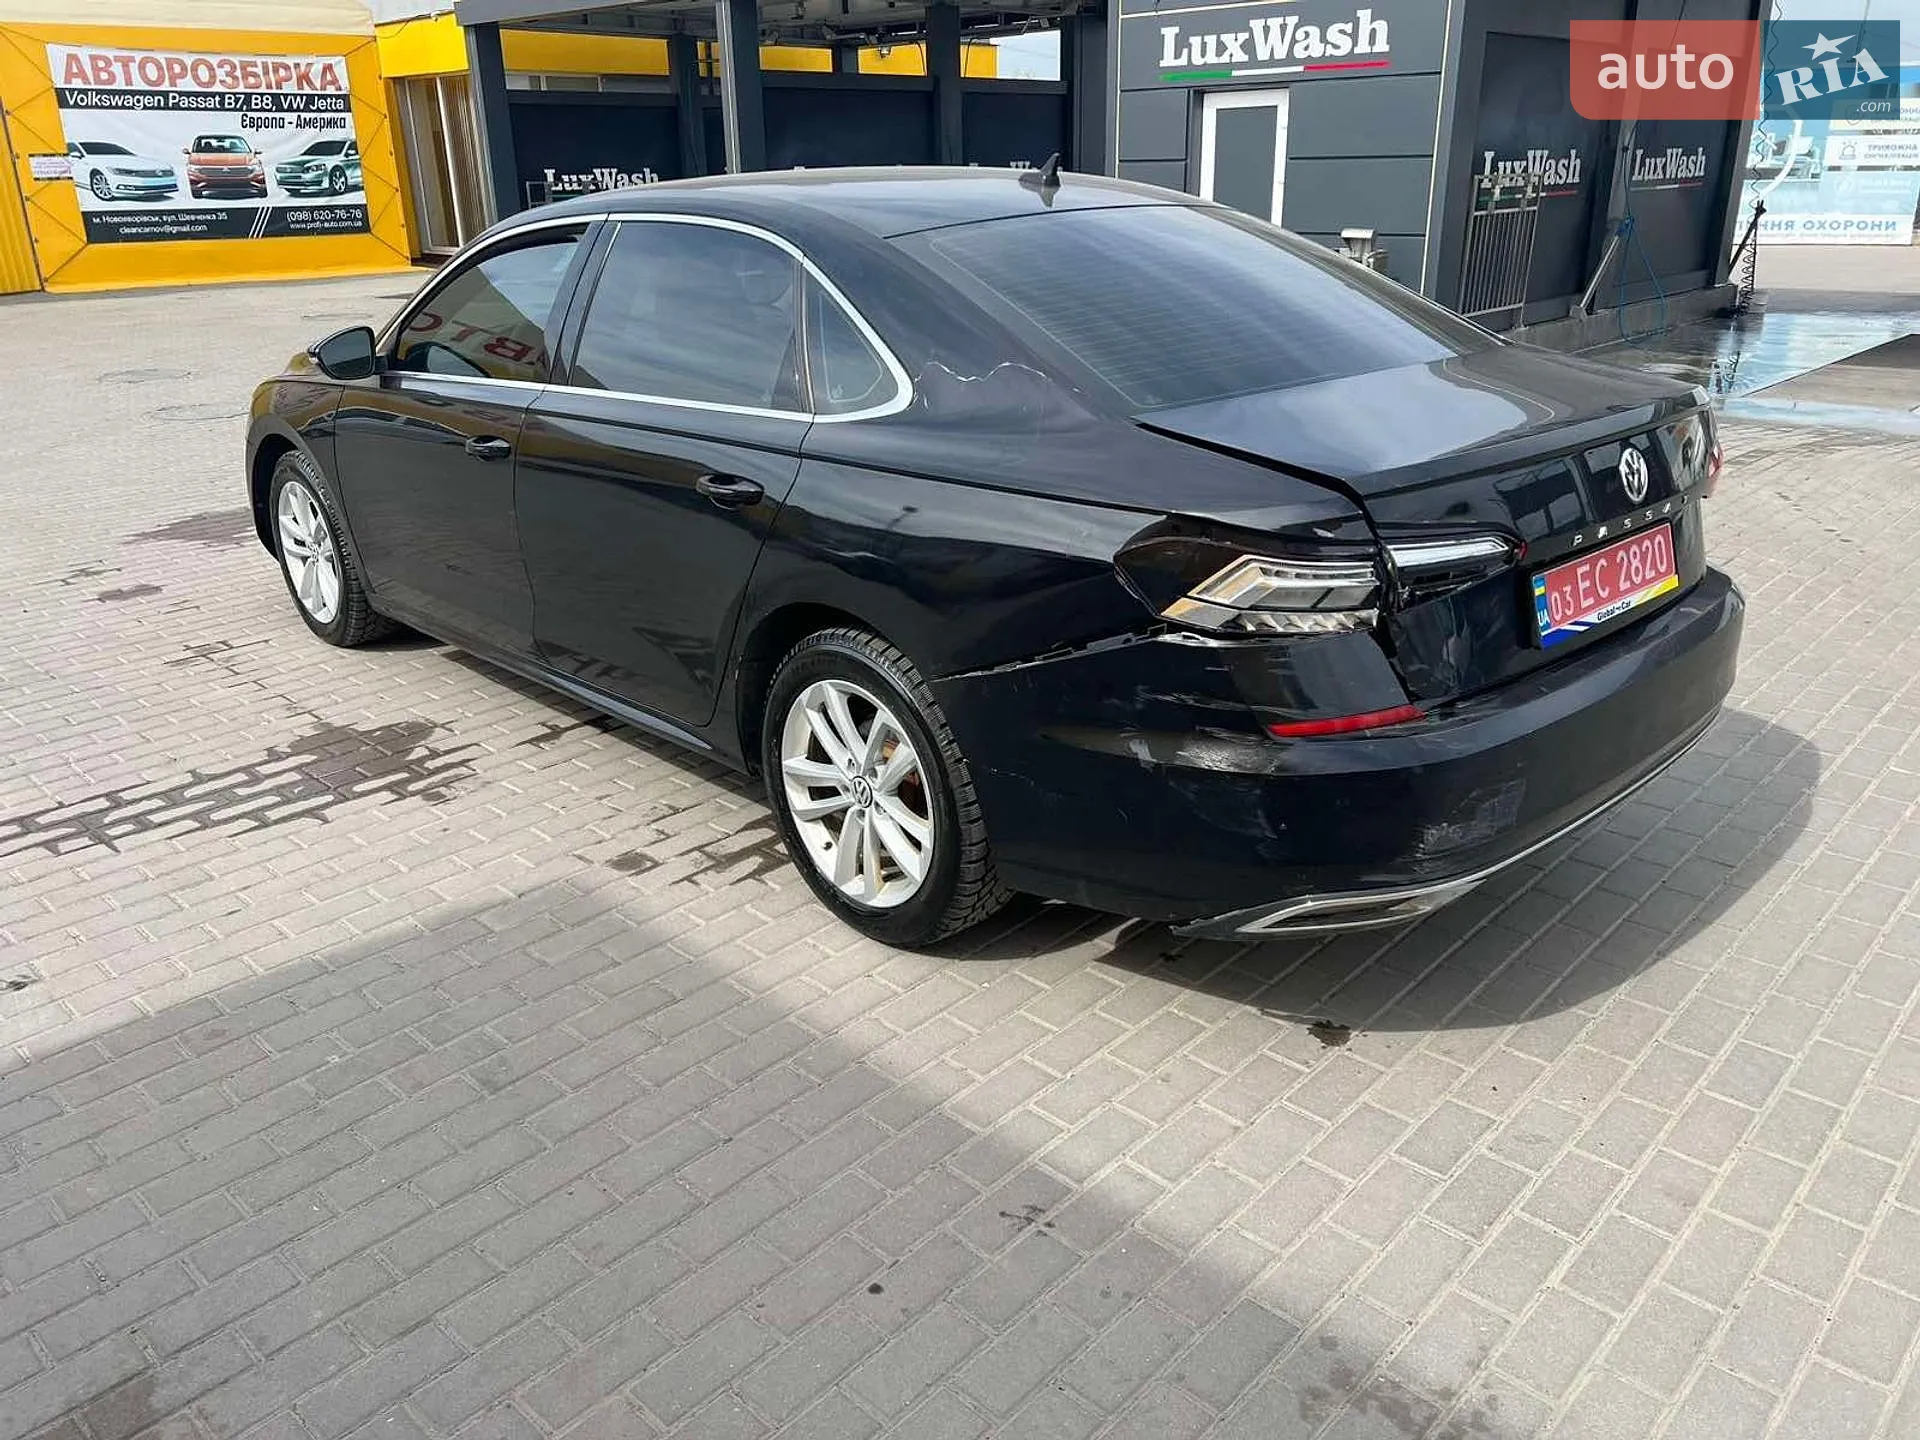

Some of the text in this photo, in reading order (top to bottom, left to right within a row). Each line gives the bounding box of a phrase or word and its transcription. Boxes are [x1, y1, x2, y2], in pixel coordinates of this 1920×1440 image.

[1159, 8, 1390, 67] LuxWash
[63, 53, 342, 92] АВТОРОЗБІРКА
[65, 91, 345, 111] Volkswagen Passat B7, B8, VW Jetta
[241, 113, 285, 132] Європа
[296, 114, 346, 132] Америка
[1480, 149, 1581, 189] LuxWash
[1632, 147, 1705, 181] LuxWash
[543, 167, 659, 191] LuxWash
[287, 209, 362, 222] (098) 620-76-76
[1803, 220, 1897, 231] ОХОРОНИ
[1550, 533, 1668, 621] 03 EC 2820
